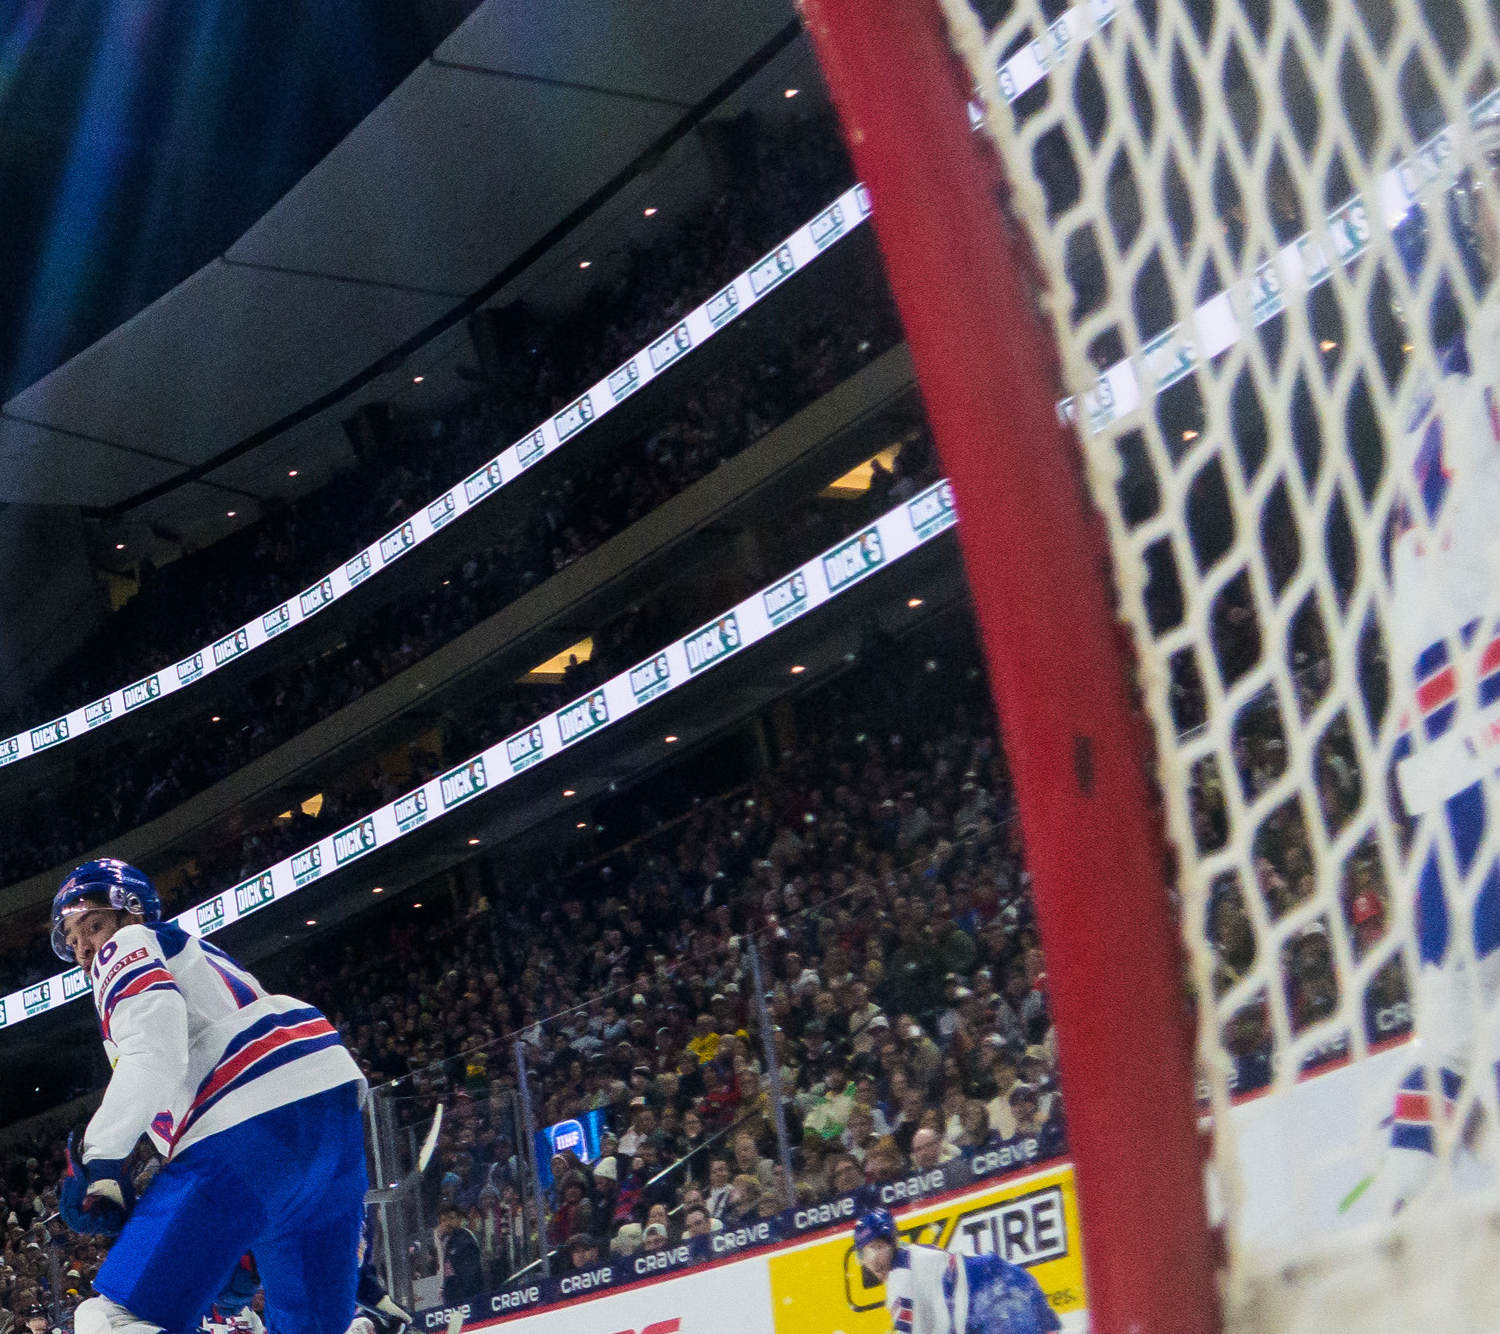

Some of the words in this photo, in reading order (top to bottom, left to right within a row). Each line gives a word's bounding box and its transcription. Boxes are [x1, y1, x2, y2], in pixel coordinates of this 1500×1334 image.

[466, 463, 500, 503] DICK'S
[381, 524, 414, 561] DICK'S
[825, 530, 883, 591] DICK'S
[215, 630, 247, 663] DICK'S
[687, 617, 740, 670] DICK'S
[32, 720, 68, 749] DICK'S
[558, 692, 607, 742] DICK'S
[335, 819, 375, 863] DICK'S
[237, 874, 273, 912] DICK'S
[962, 1189, 1066, 1265] TIRE
